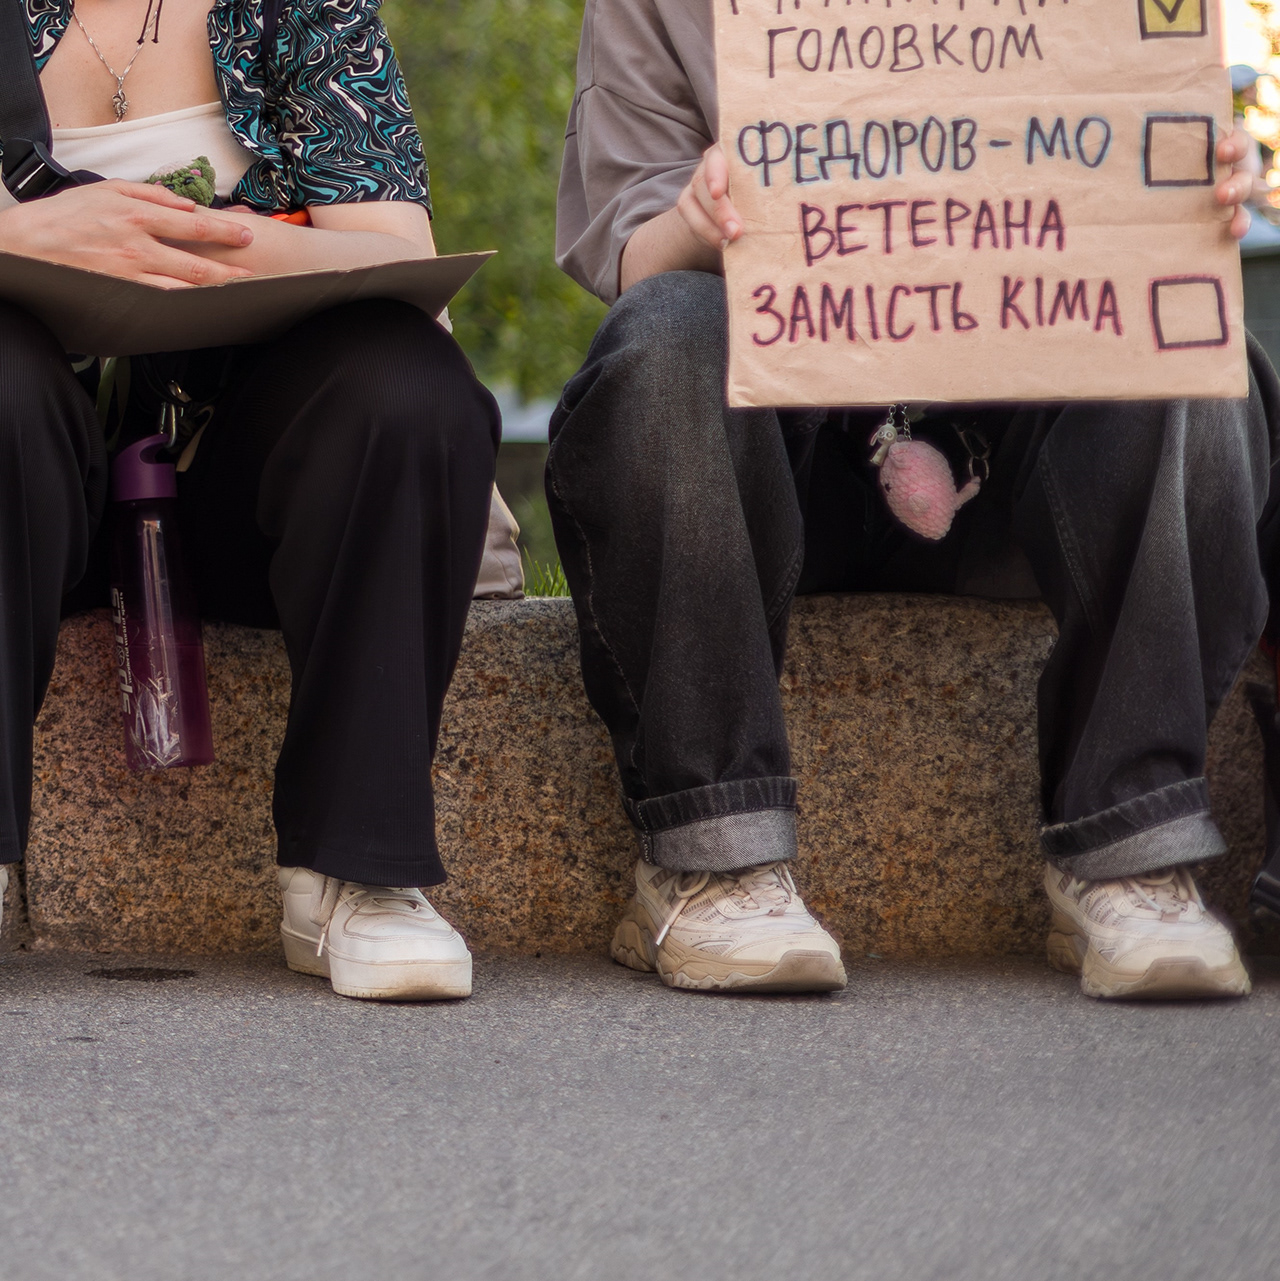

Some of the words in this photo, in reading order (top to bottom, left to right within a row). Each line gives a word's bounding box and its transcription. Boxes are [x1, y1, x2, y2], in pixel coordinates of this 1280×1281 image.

[768, 23, 1044, 78] ГОЛОВКОМ
[800, 198, 1066, 267] ВЕТЕРАНА
[751, 280, 979, 346] ЗАМІСТЬ
[999, 275, 1124, 337] КІМА
